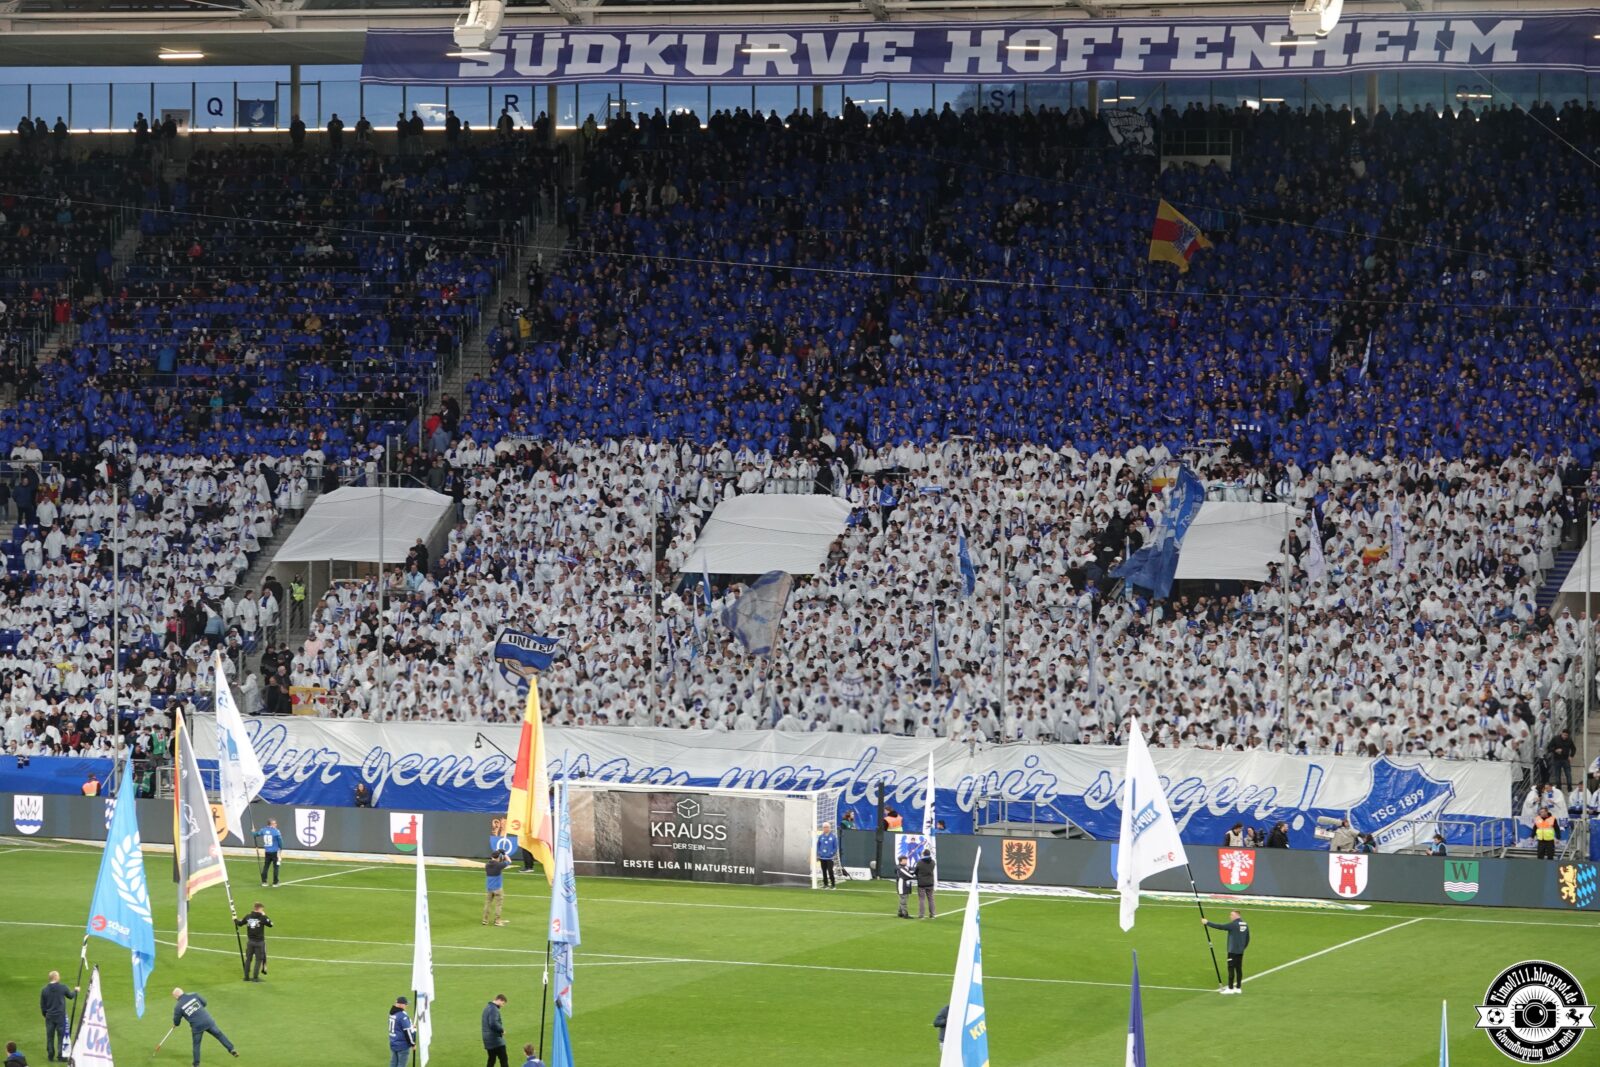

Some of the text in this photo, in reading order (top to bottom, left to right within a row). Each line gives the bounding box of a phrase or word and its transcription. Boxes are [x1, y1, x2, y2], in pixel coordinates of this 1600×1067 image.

[459, 20, 1524, 78] SÜDKURVE HOFFENHEIM
[207, 97, 223, 116] Q
[505, 94, 519, 112] R
[990, 90, 1016, 109] S1
[508, 634, 555, 653] UNITED
[361, 746, 691, 807] gemesam
[956, 755, 1058, 813] wir
[1371, 789, 1425, 822] TSG 1899
[651, 822, 727, 841] KRAUSS
[687, 843, 706, 851] STEIN
[623, 860, 654, 869] ERSTE
[658, 861, 681, 870] LIGA
[694, 864, 755, 875] NATURSTEIN
[1450, 863, 1472, 880] W
